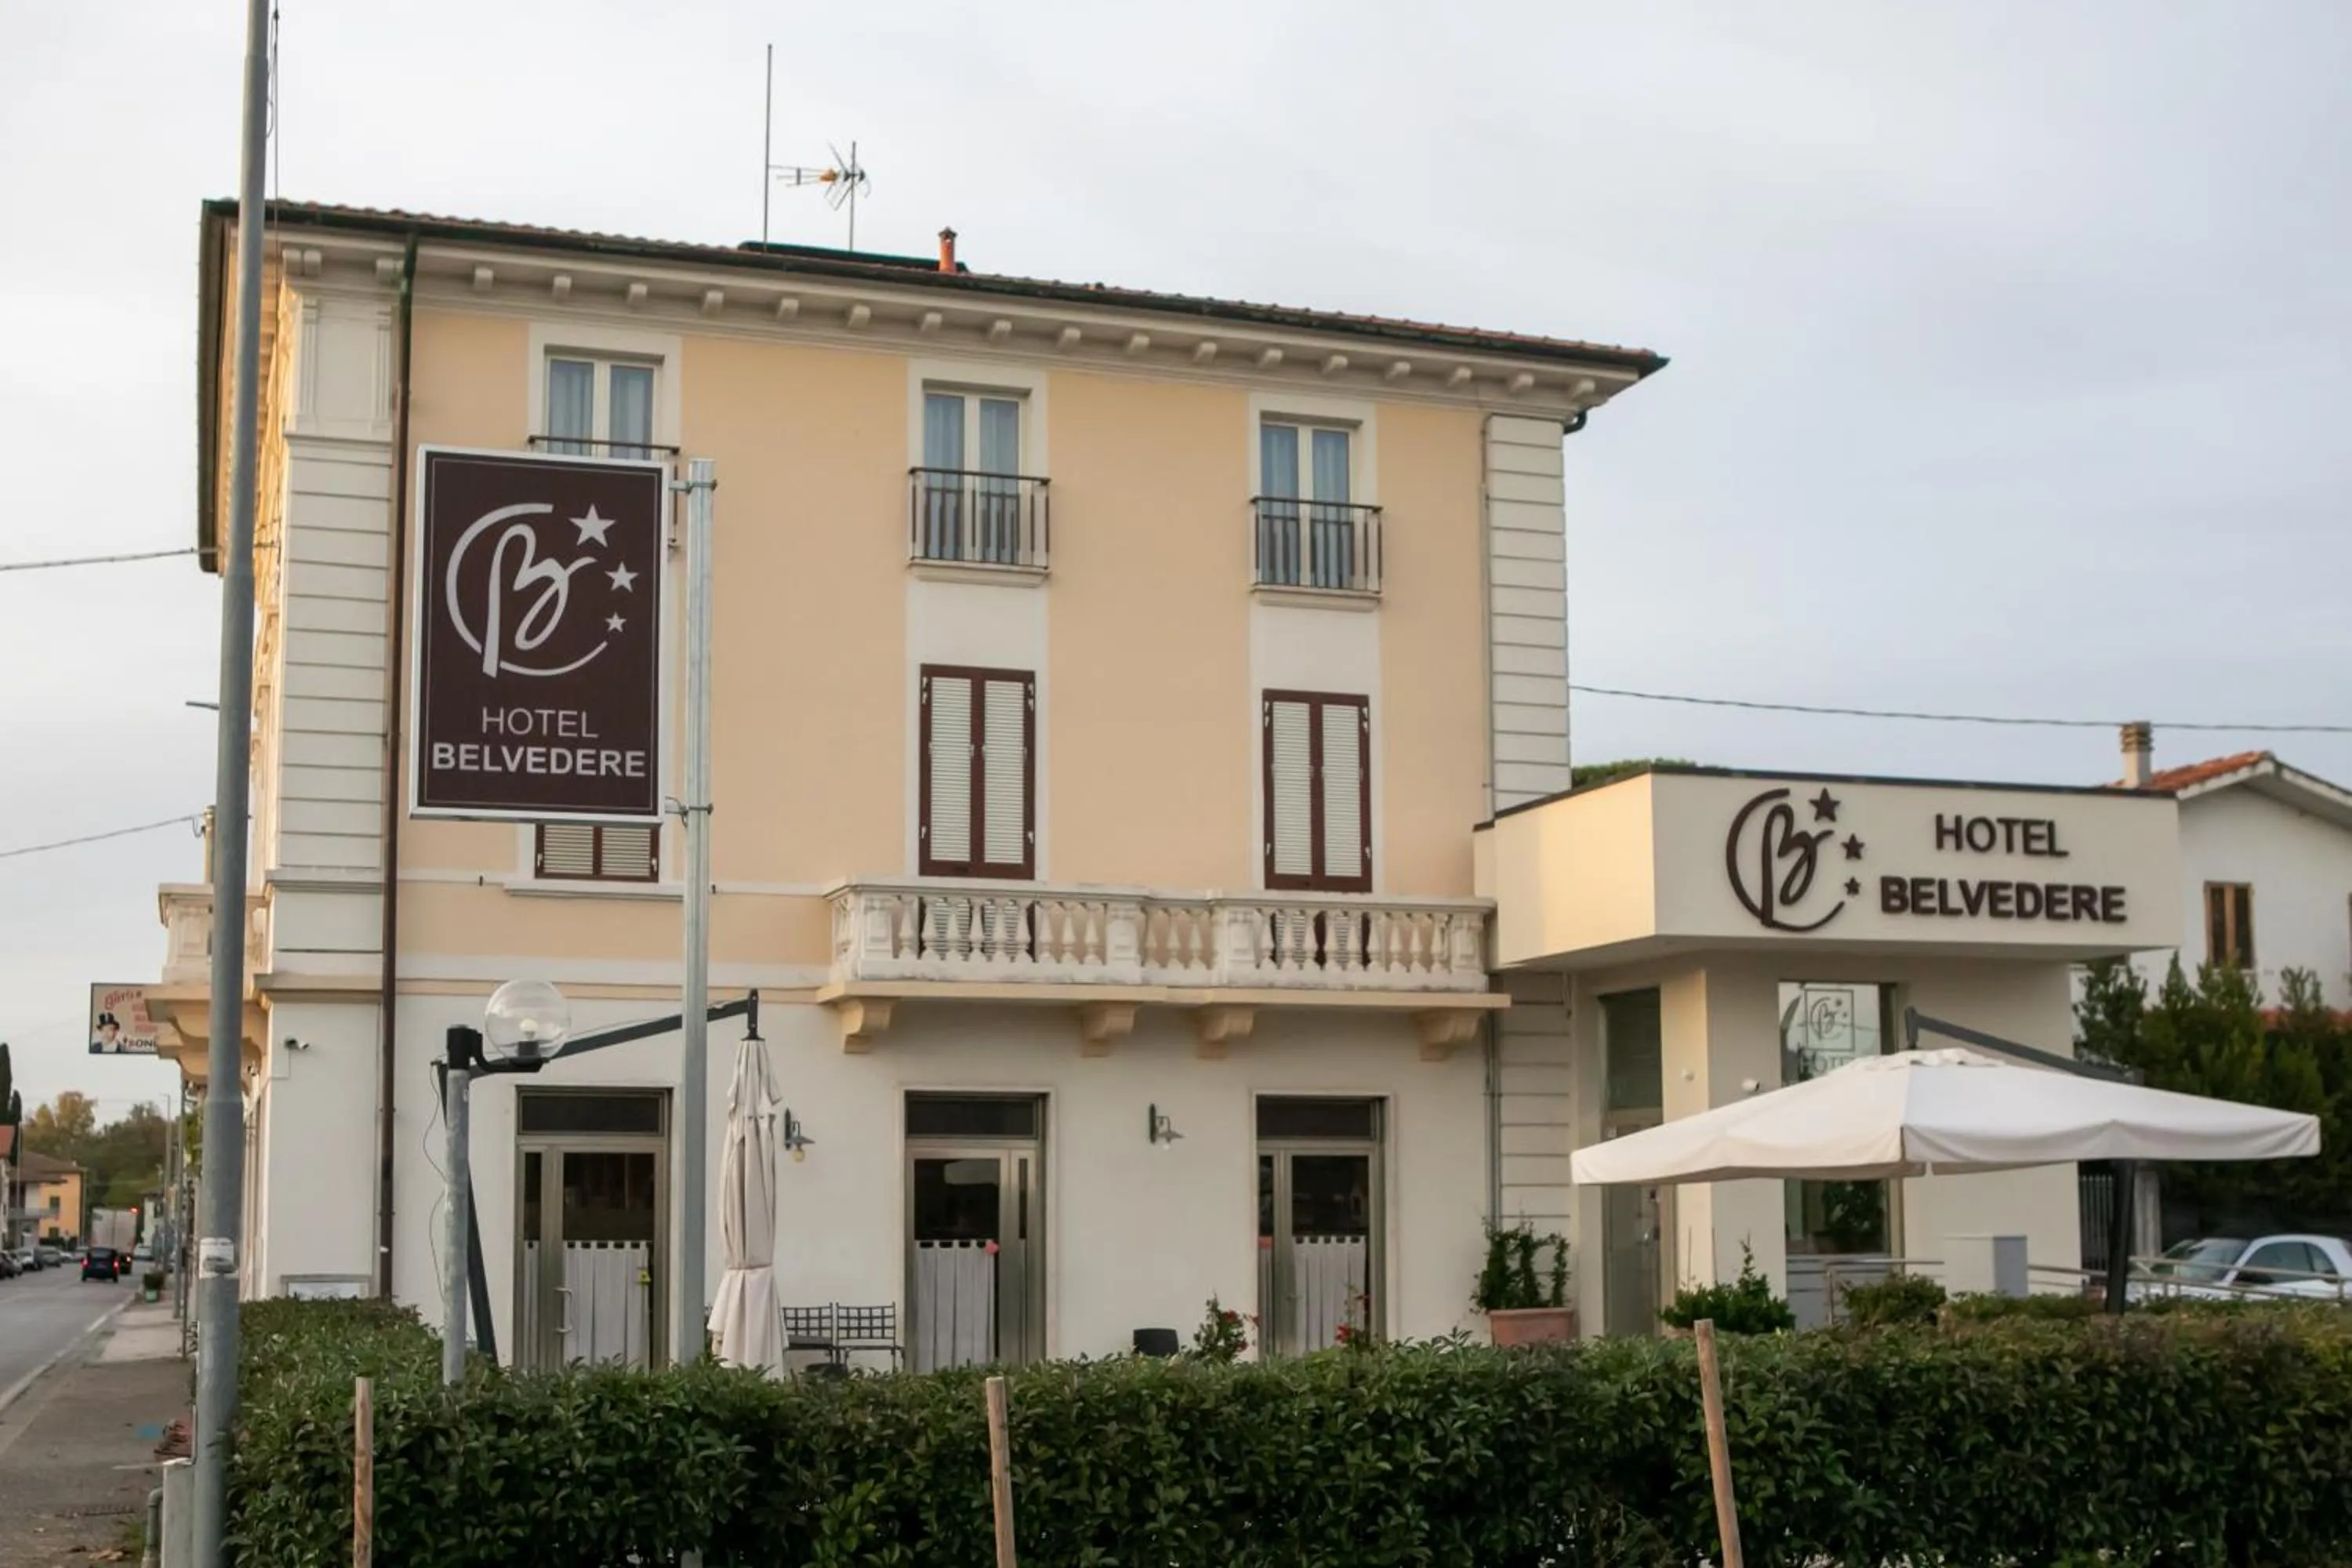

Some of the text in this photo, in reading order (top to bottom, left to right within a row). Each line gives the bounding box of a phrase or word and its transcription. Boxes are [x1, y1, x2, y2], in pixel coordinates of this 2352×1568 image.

[481, 706, 599, 739] HOTEL
[432, 742, 646, 778] BELVEDERE
[1935, 813, 2070, 858] HOTEL
[1879, 874, 2128, 924] BELVEDERE
